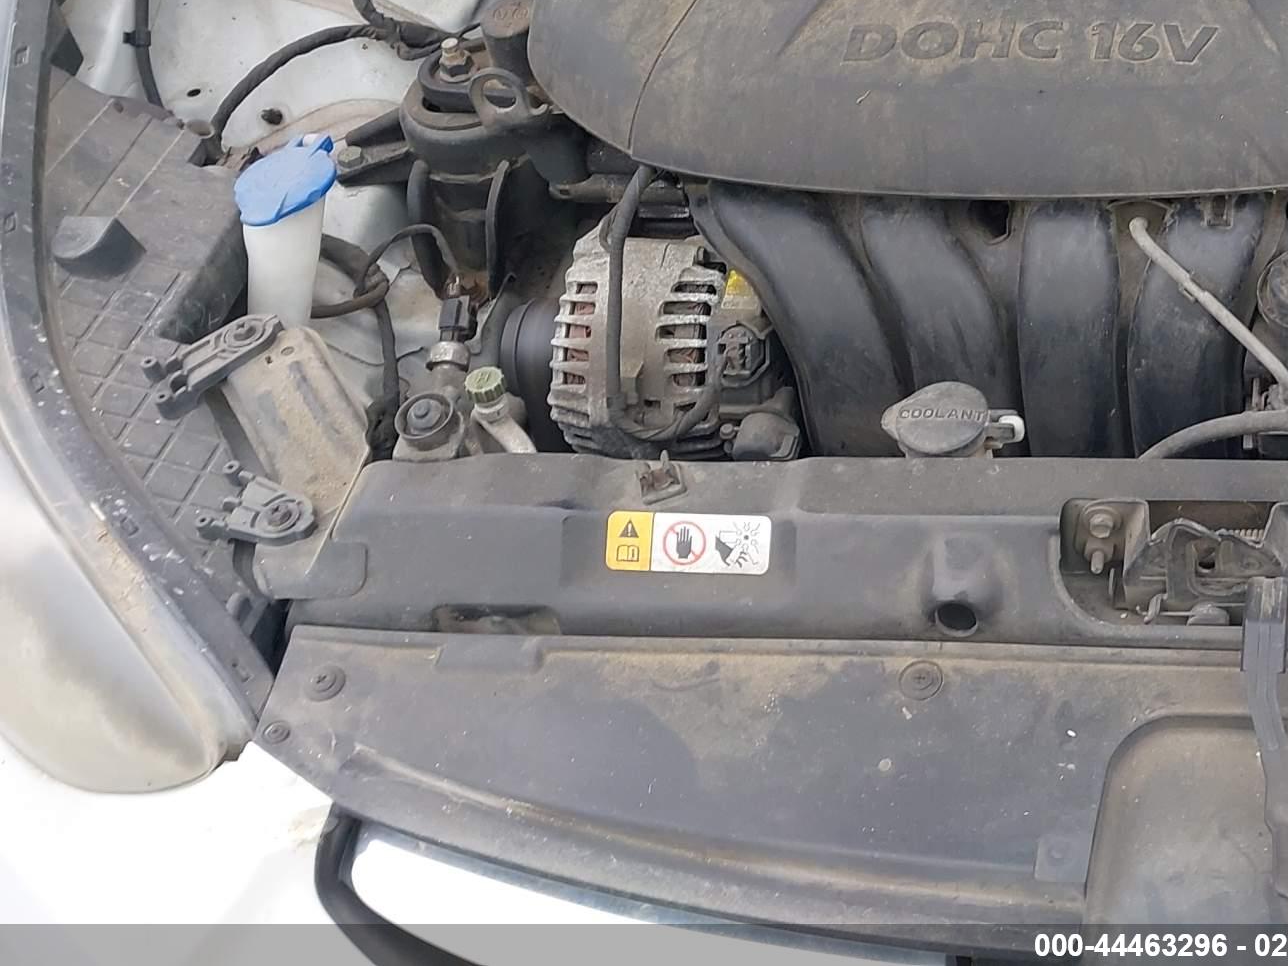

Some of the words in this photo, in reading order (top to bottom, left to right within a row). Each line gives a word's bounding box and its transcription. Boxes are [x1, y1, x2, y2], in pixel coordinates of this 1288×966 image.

[841, 20, 1065, 63] DOHC
[1090, 21, 1220, 65] 16V
[900, 408, 986, 422] COOLANT
